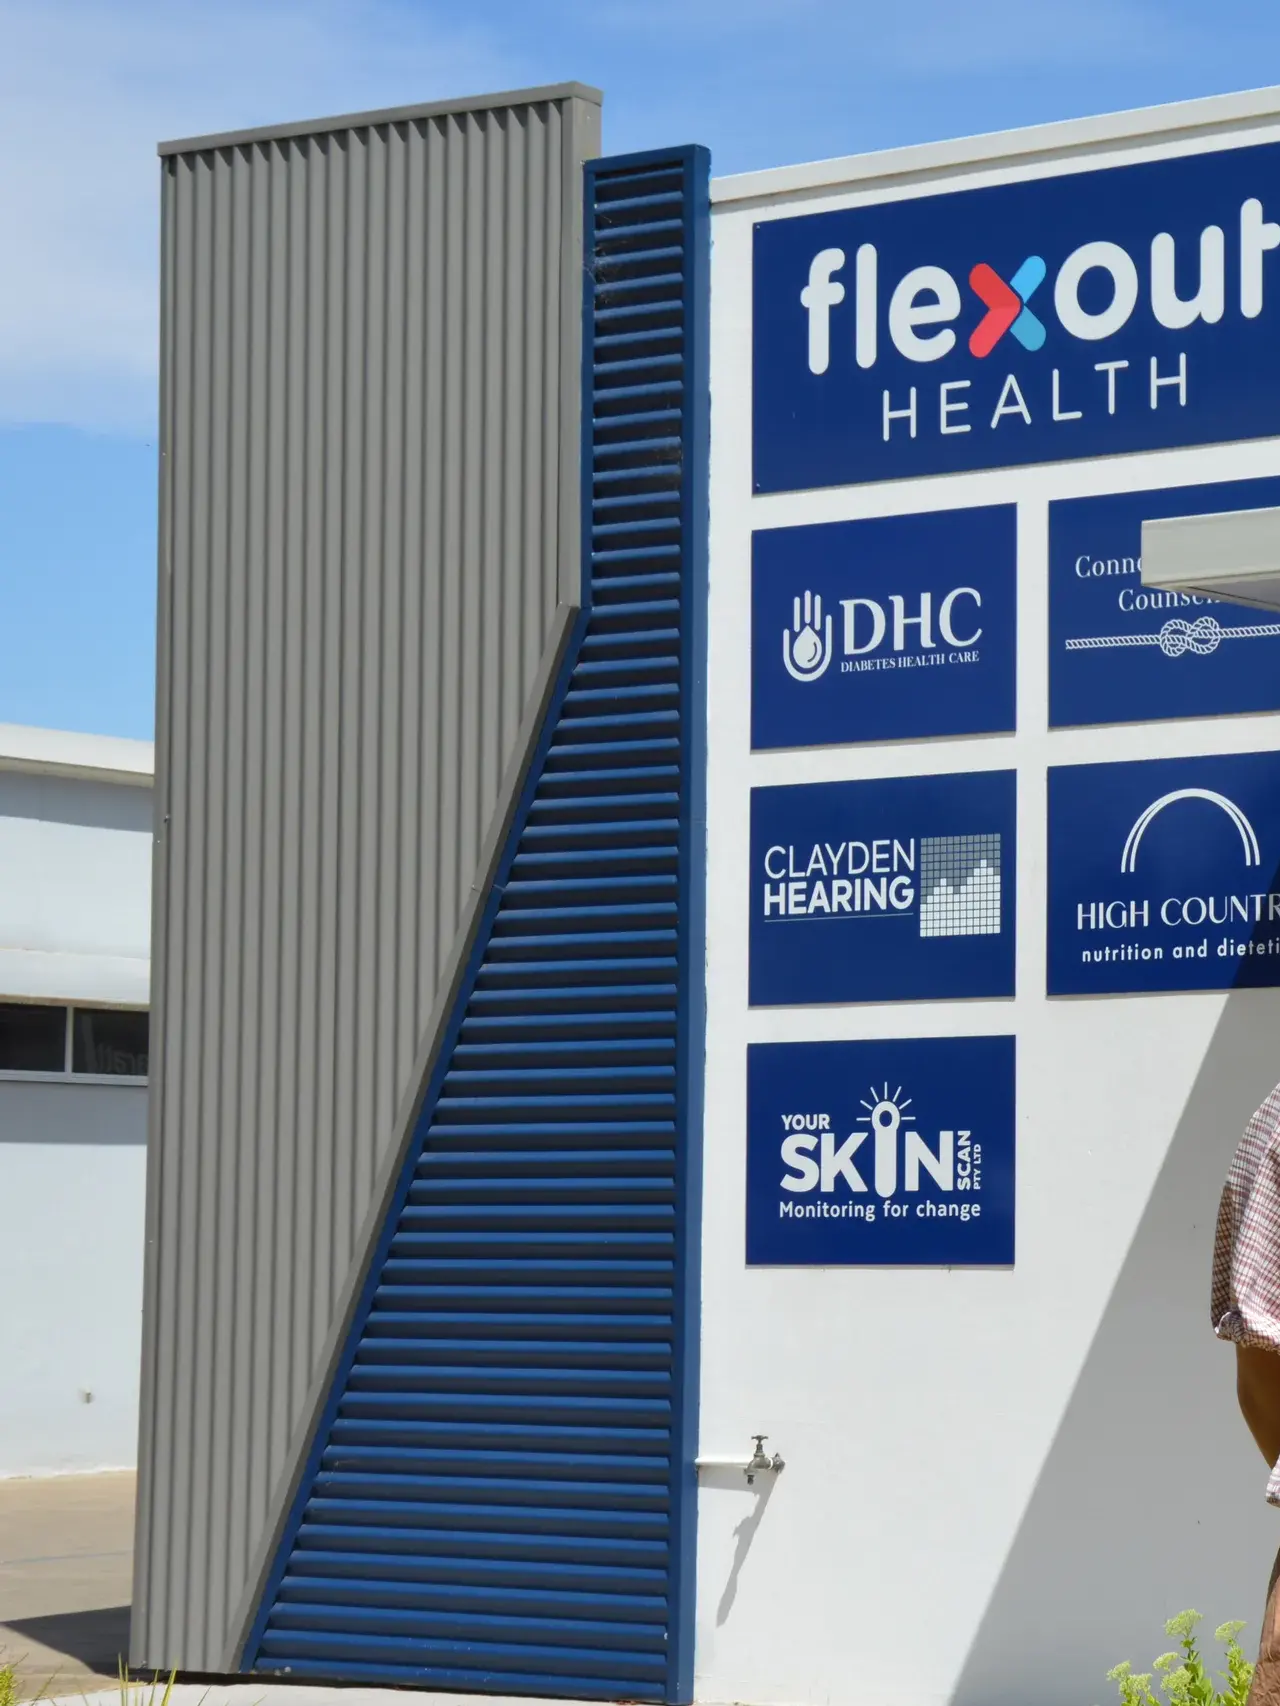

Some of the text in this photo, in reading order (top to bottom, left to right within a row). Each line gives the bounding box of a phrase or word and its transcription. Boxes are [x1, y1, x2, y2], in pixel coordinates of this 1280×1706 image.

[882, 352, 1187, 442] HEALTH
[839, 587, 983, 655] DHC
[840, 651, 980, 673] DIABETES HEALTH CARE
[764, 838, 915, 879] CLAYDEN
[764, 875, 915, 916] HEARING
[1077, 899, 1149, 930] HIGH
[1082, 943, 1163, 963] nutrition
[1172, 939, 1208, 959] and
[781, 1113, 831, 1131] YOUR
[779, 1100, 954, 1199] SKIN
[957, 1130, 972, 1191] SCAN
[973, 1143, 982, 1190] PTY LTD
[779, 1200, 982, 1222] Monitoring for change
